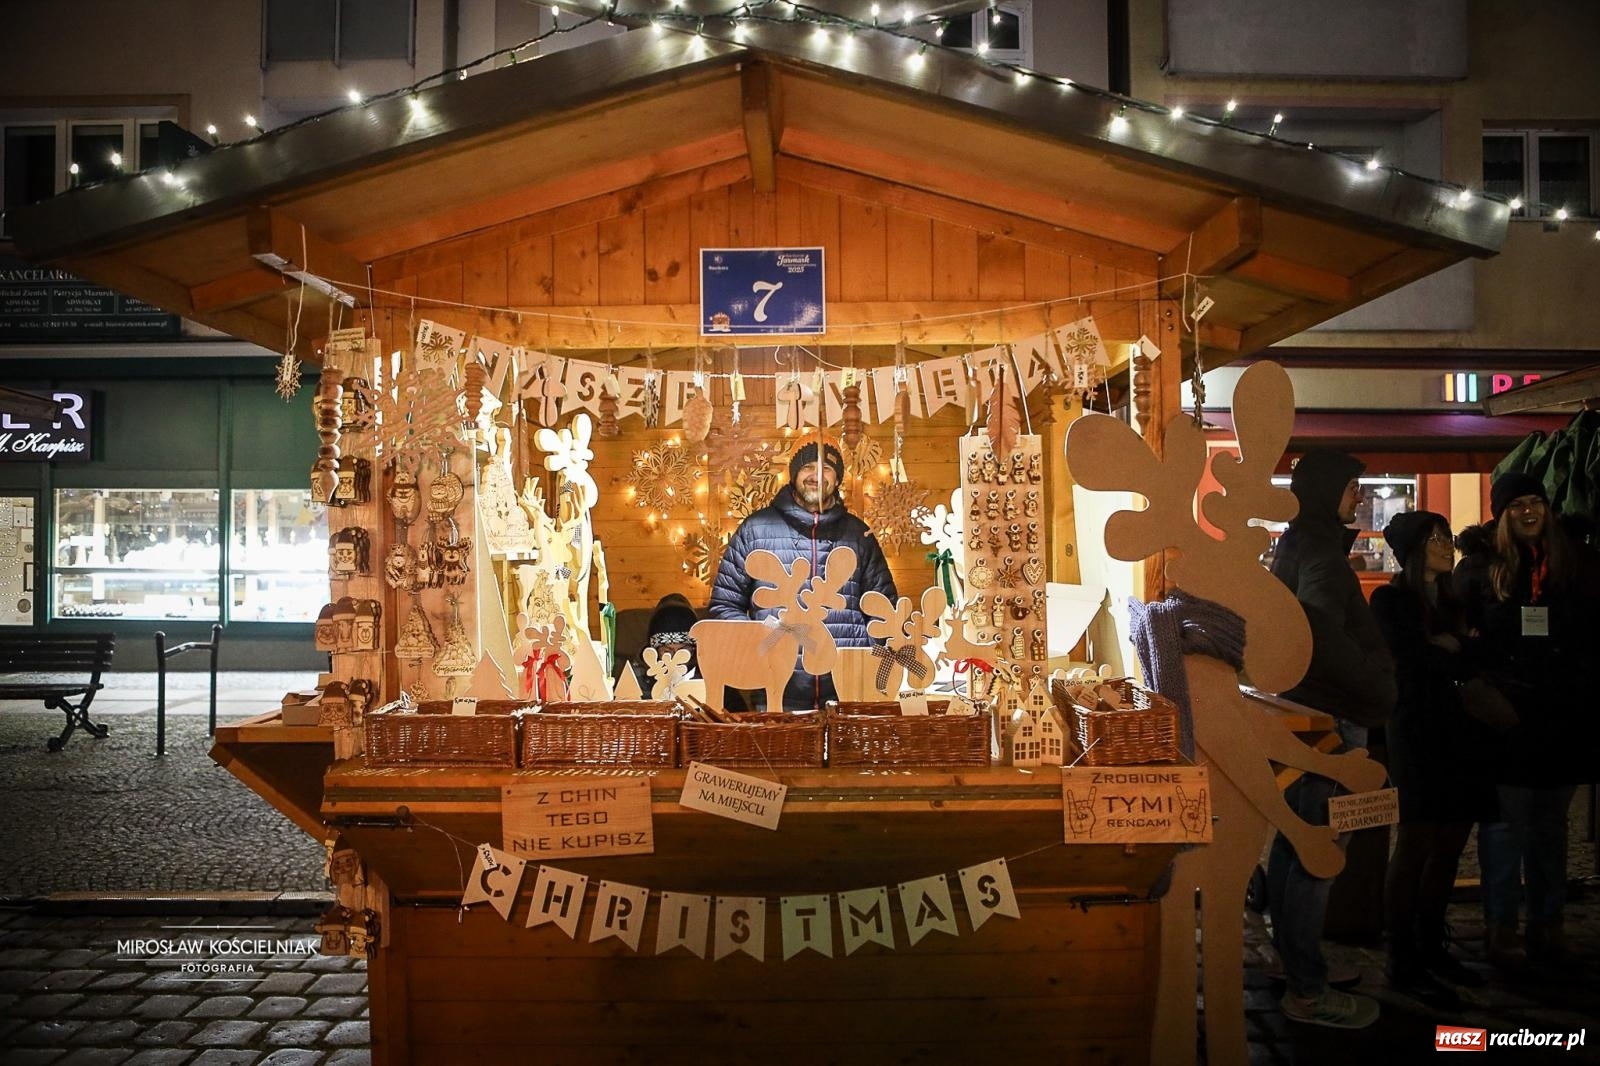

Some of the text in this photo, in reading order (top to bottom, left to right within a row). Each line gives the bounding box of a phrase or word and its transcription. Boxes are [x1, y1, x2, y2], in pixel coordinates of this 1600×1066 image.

[776, 254, 810, 267] Jarmark
[752, 281, 783, 322] 7
[693, 771, 780, 801] GRAWERUJEMY
[1091, 772, 1182, 784] ZROBIONE
[537, 787, 617, 805] Z CHIN
[698, 789, 766, 817] NA MIEJSCU
[1101, 796, 1173, 813] TYMI
[546, 811, 609, 827] TEGO
[1106, 818, 1171, 828] RENCAMI
[1337, 819, 1350, 830] ZA
[1350, 814, 1384, 828] DARMO
[512, 831, 648, 852] NIE KUPISZ
[480, 863, 1001, 945] CHRISTMAS
